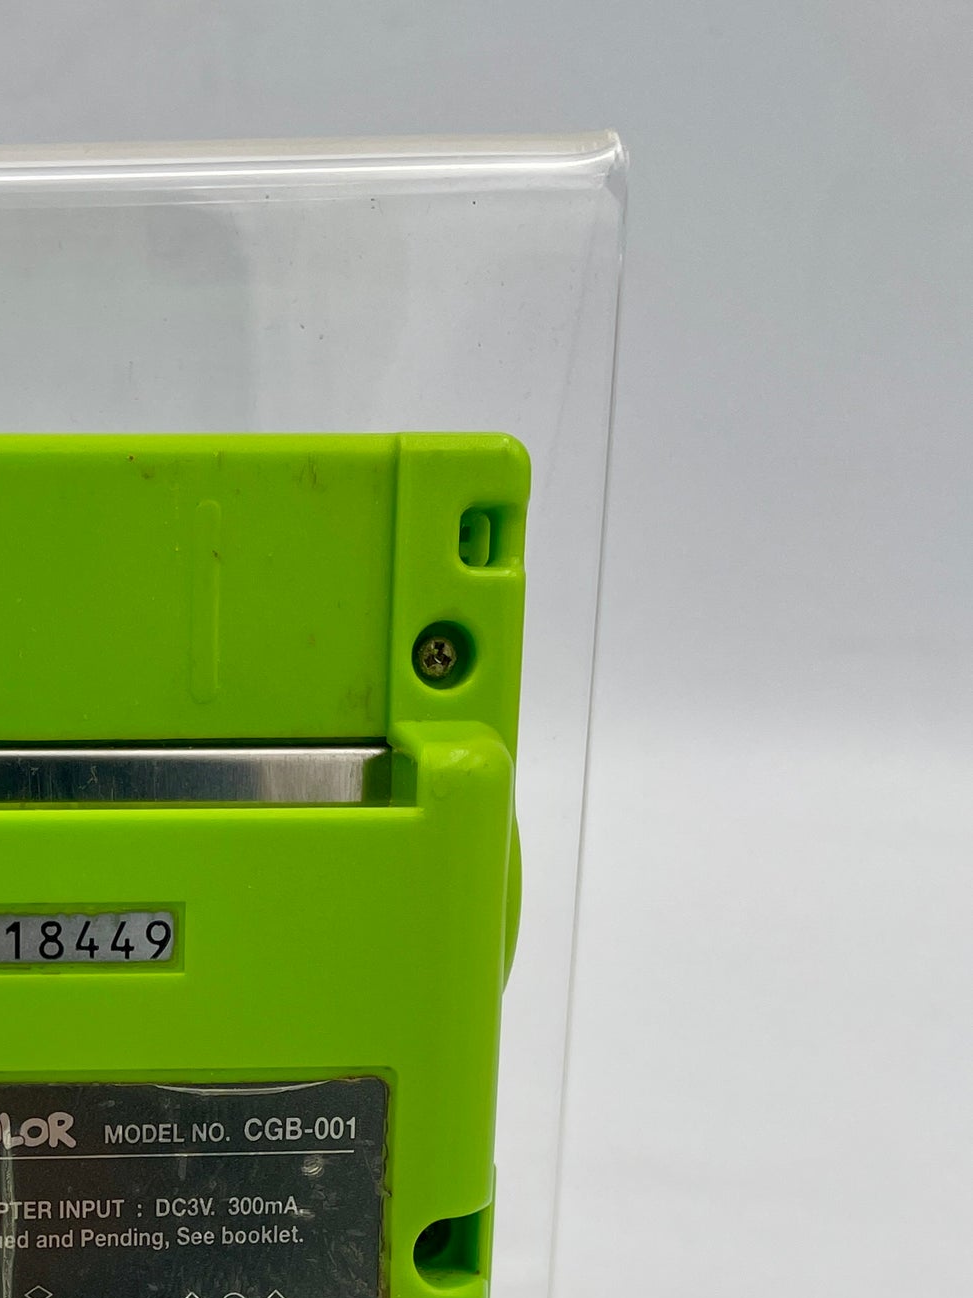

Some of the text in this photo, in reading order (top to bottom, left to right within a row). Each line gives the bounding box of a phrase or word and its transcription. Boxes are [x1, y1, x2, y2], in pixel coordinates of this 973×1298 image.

[105, 1117, 356, 1144] MODEL NO. CGB-001
[59, 1199, 125, 1219] INPUT
[36, 1230, 73, 1248] and
[81, 1228, 169, 1251] Pending,
[177, 1228, 214, 1245] See
[222, 1226, 303, 1244] booklet.
